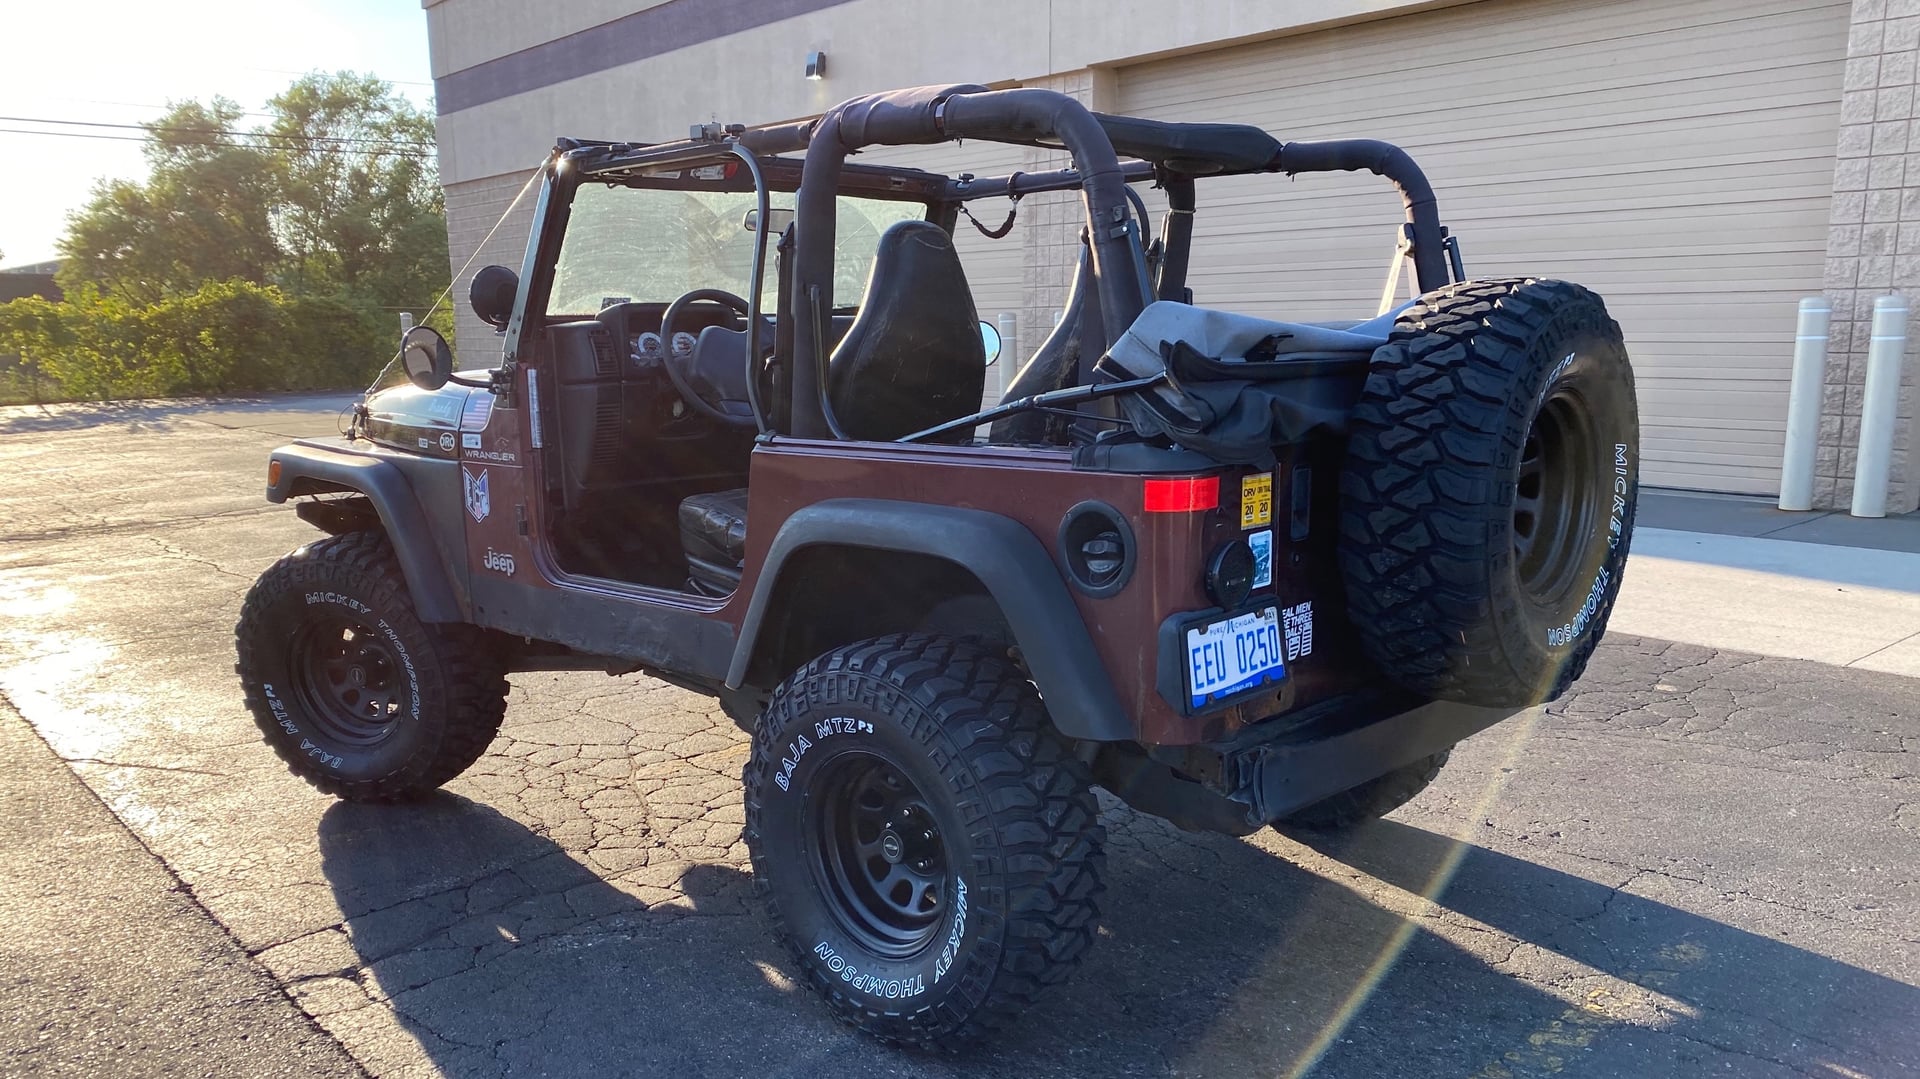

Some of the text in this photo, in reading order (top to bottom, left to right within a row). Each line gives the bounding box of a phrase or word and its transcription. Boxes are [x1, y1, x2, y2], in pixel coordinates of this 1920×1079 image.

[464, 449, 515, 461] WRANGLER
[1243, 487, 1256, 498] ORV
[1245, 504, 1254, 516] 20
[1259, 501, 1269, 513] 20
[1548, 443, 1627, 646] MICKEY THOMPSON
[484, 547, 515, 576] Jeep
[1282, 600, 1312, 619] EAL MEN
[1291, 610, 1313, 626] THREE
[1224, 617, 1256, 638] MICHIGAN
[1285, 624, 1303, 639] DALS
[305, 591, 420, 720] MICKEY THOMPSON
[1192, 624, 1279, 690] EEU 0250
[300, 738, 344, 769] BAJA
[774, 734, 812, 792] BAJA
[814, 875, 969, 998] MICKEY THOMPSON
